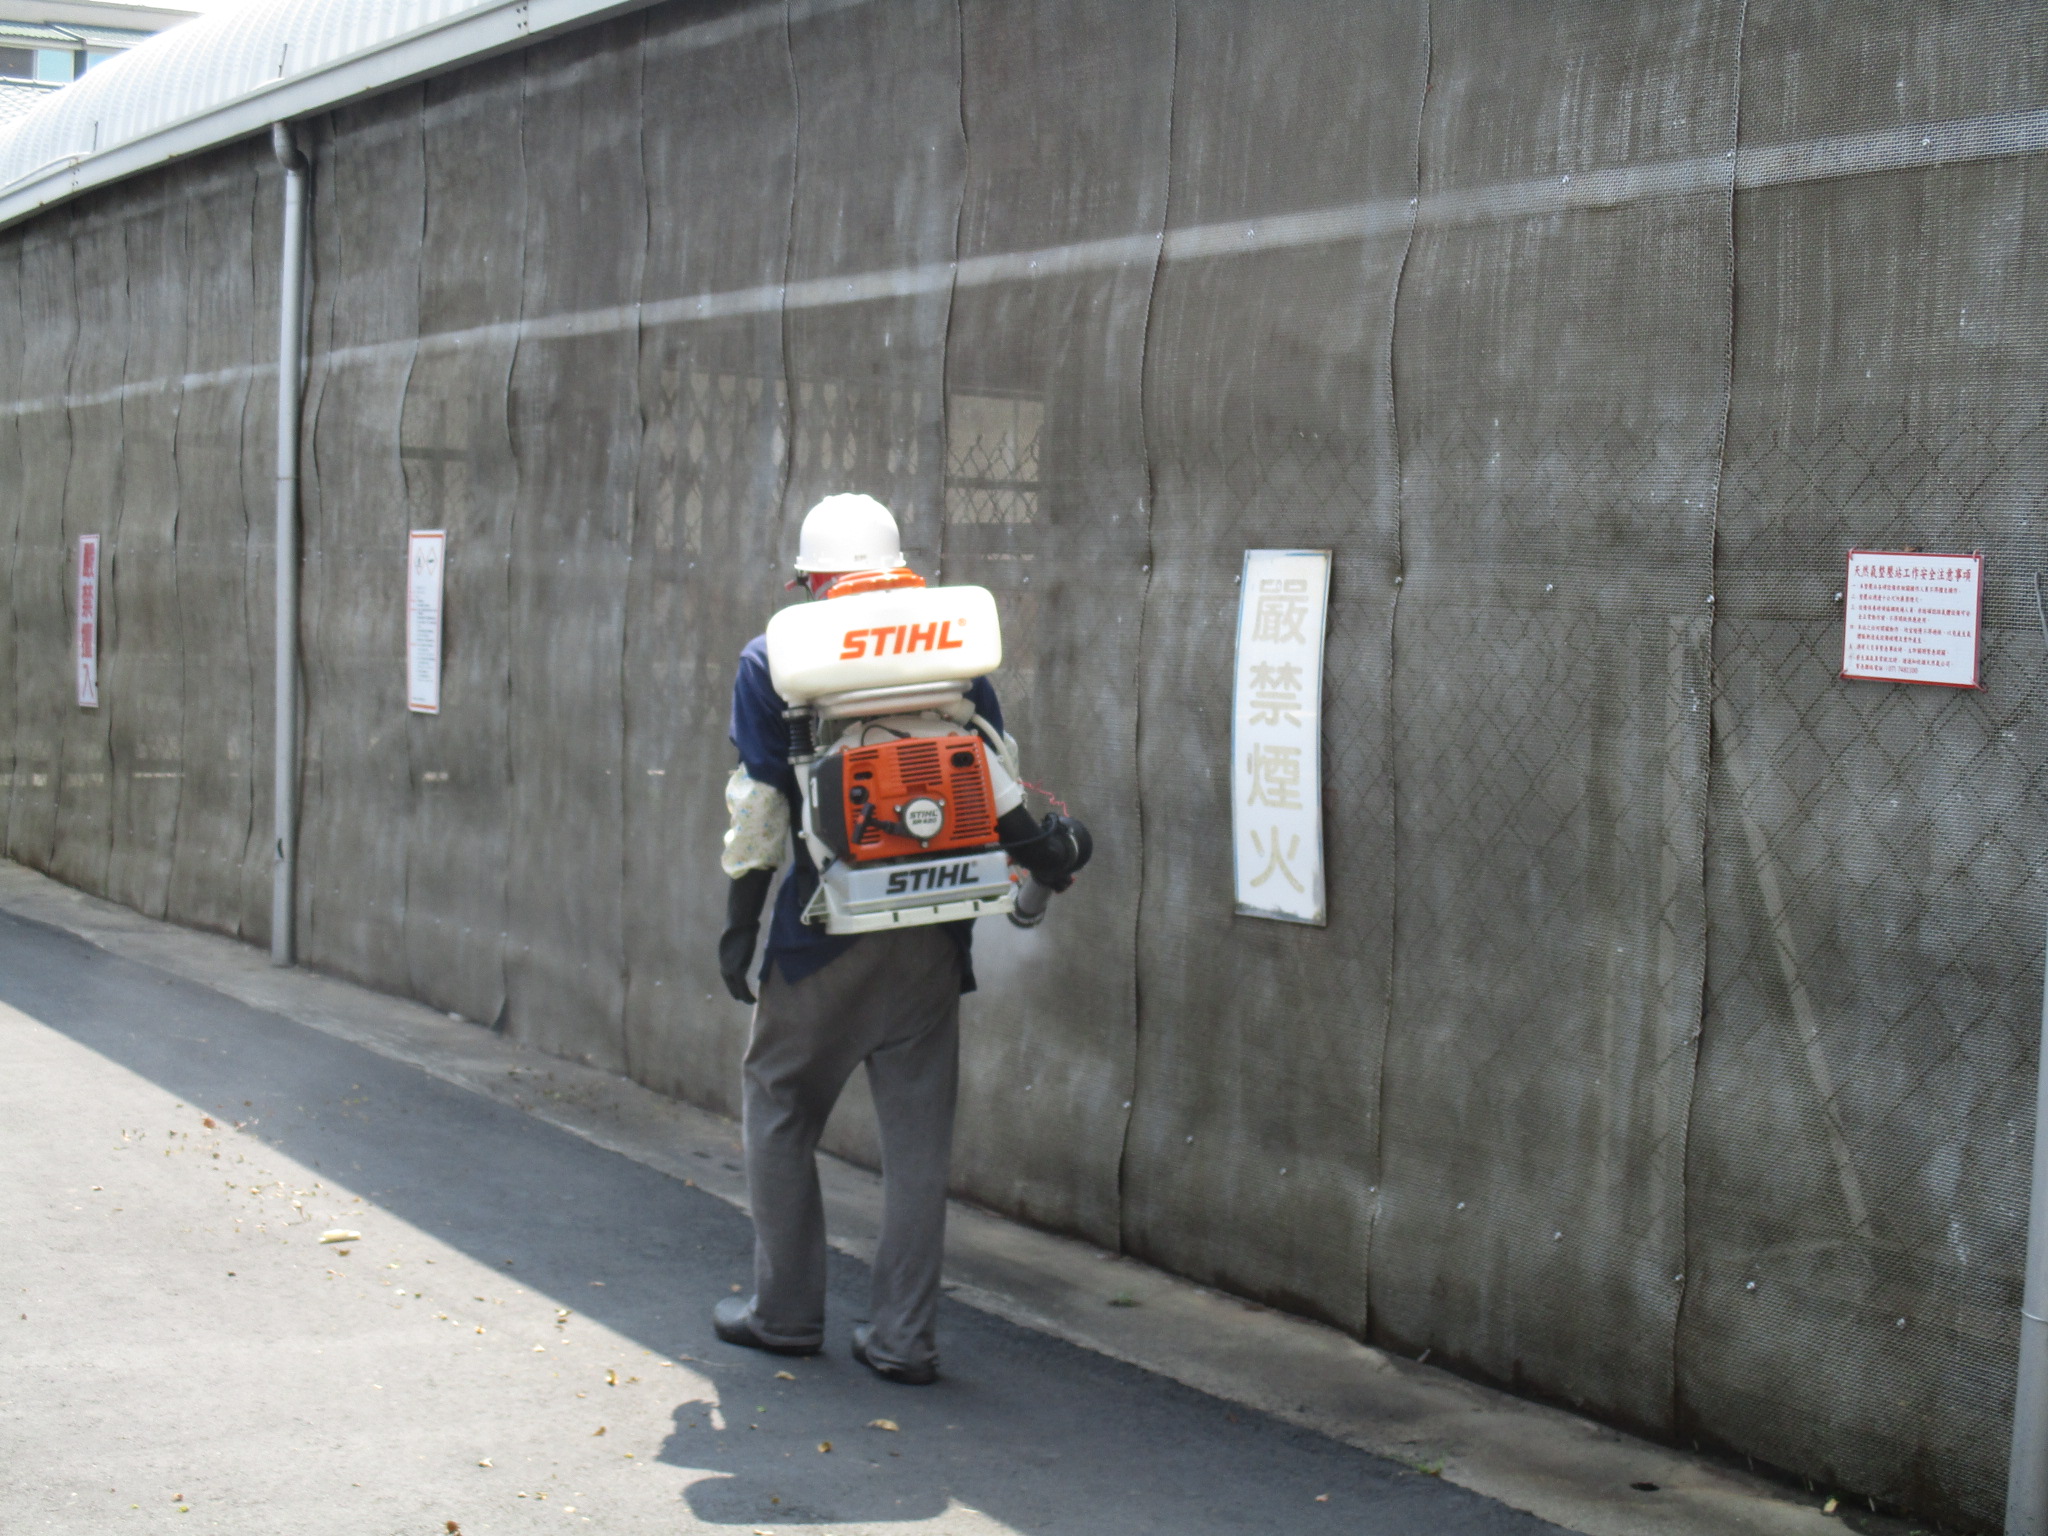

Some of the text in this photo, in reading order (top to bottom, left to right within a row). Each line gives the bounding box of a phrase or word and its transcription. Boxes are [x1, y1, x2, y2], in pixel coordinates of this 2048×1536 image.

[910, 810, 937, 819] STIHL
[1247, 578, 1308, 894] 嚴禁煙火
